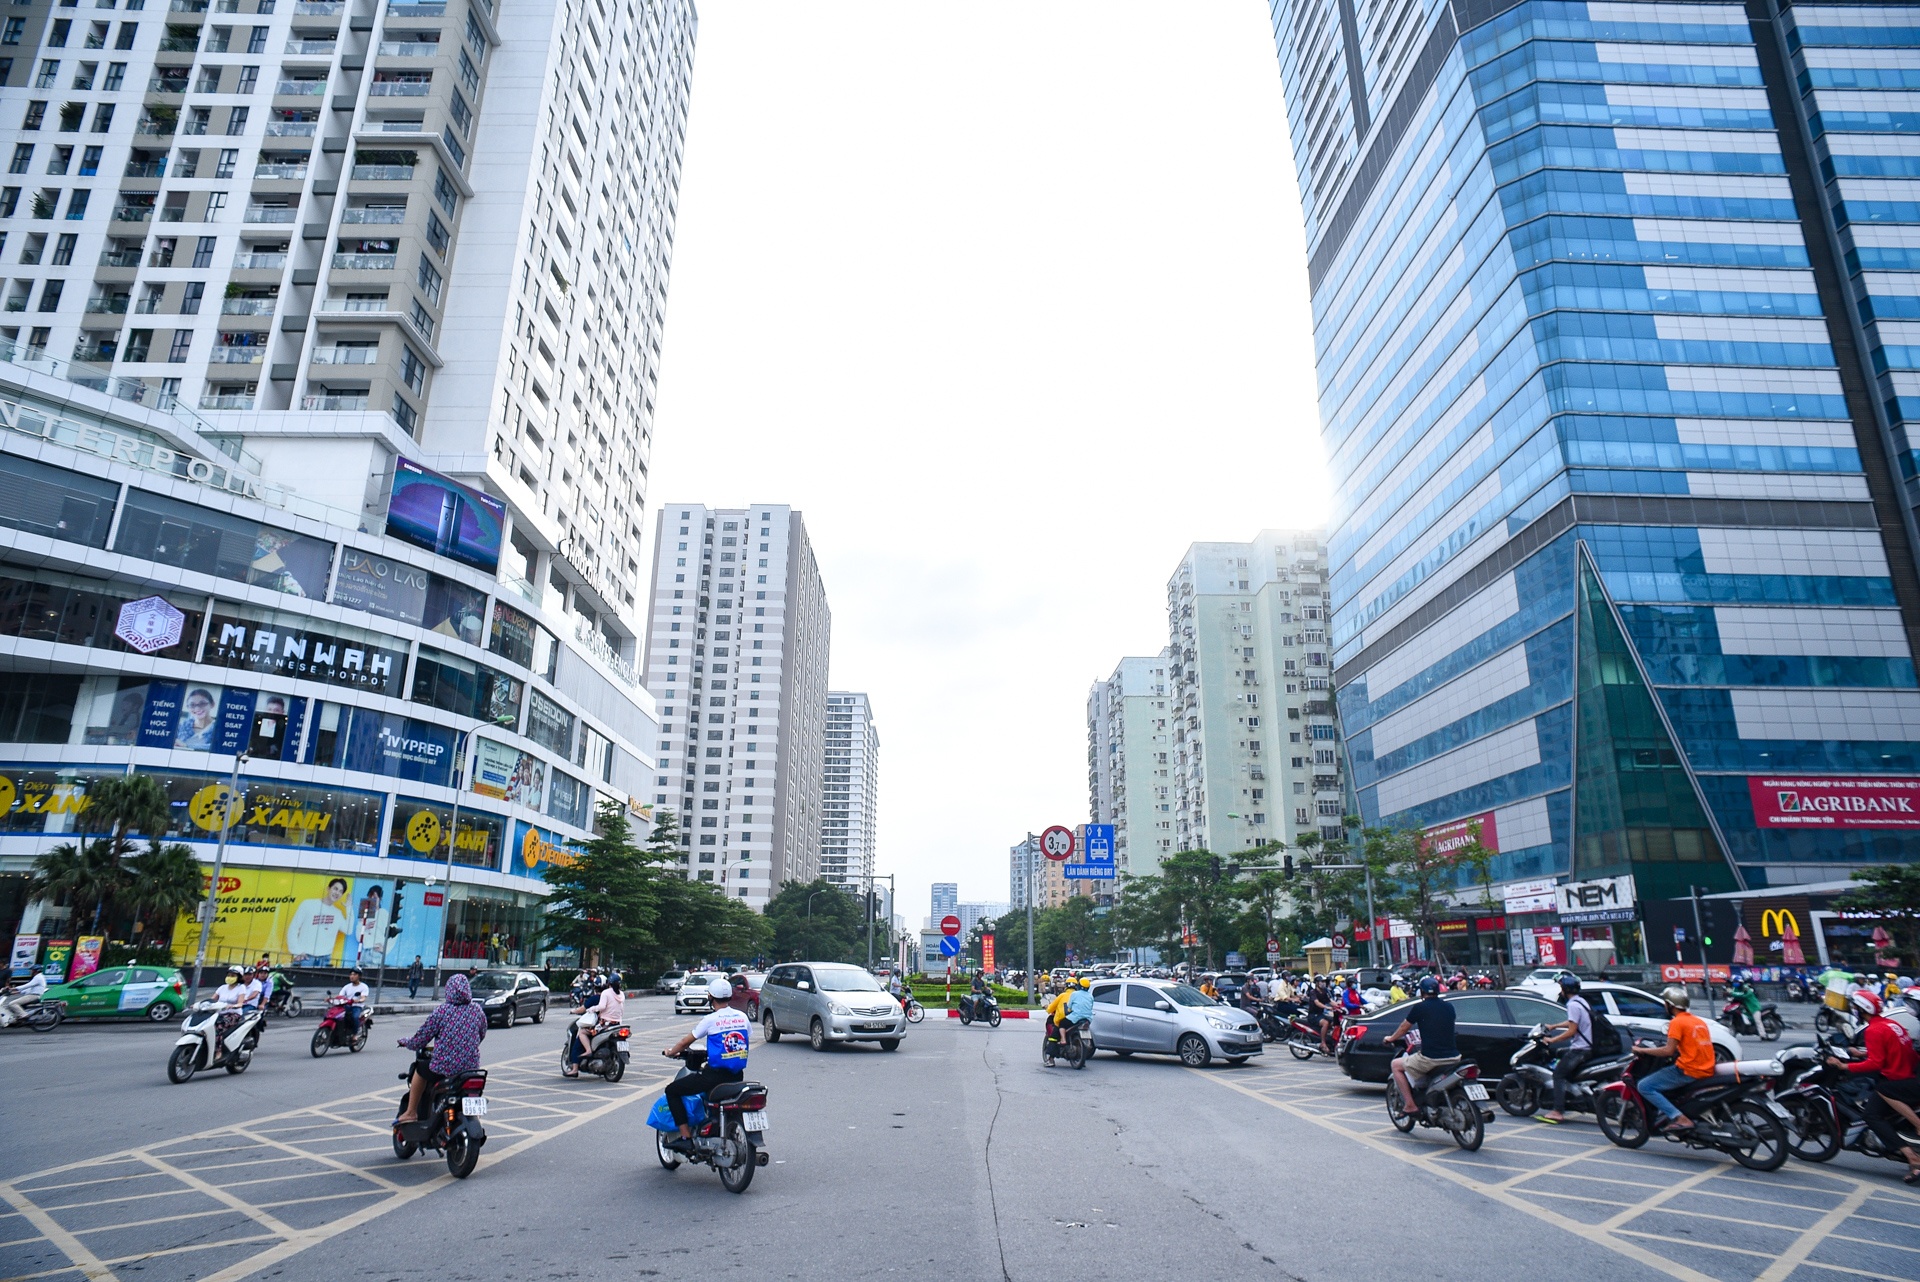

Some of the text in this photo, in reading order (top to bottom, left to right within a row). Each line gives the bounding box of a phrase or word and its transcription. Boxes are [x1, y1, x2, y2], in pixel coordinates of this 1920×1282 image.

[394, 568, 427, 590] LAO
[219, 623, 392, 677] MANWAH
[217, 647, 388, 687] TAIWANESE HOTPOT
[226, 703, 248, 711] TOEFL
[149, 720, 167, 729] HỌC
[386, 735, 444, 757] IVYPREP
[1801, 796, 1915, 813] AGRIBANK
[246, 806, 331, 831] XANH
[1066, 866, 1113, 876] LÀN DÀNH RIÊNG BRT
[1566, 883, 1617, 908] NEM
[1540, 943, 1552, 956] 70
